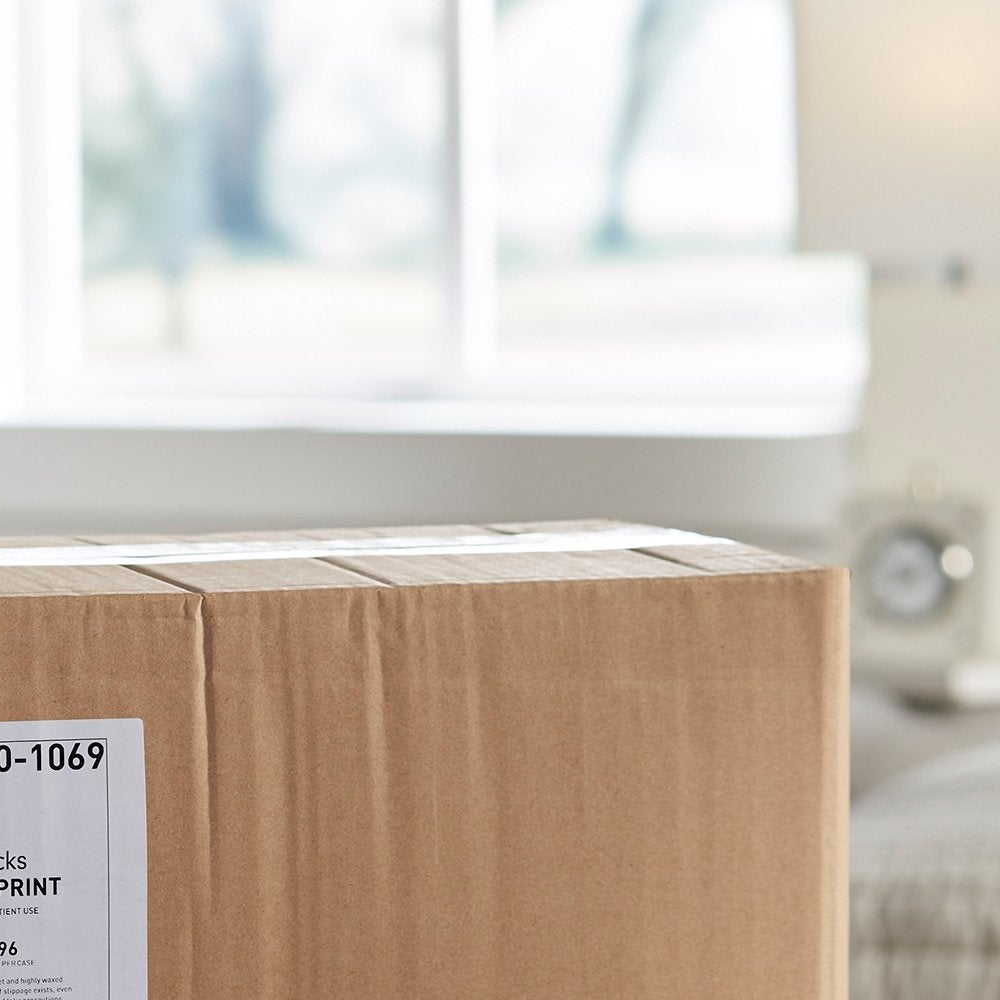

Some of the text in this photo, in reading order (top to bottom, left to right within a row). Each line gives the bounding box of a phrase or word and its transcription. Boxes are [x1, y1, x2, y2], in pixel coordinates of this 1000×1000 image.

[23, 906, 39, 915] USE
[20, 977, 40, 986] highly
[3, 988, 32, 996] slippage
